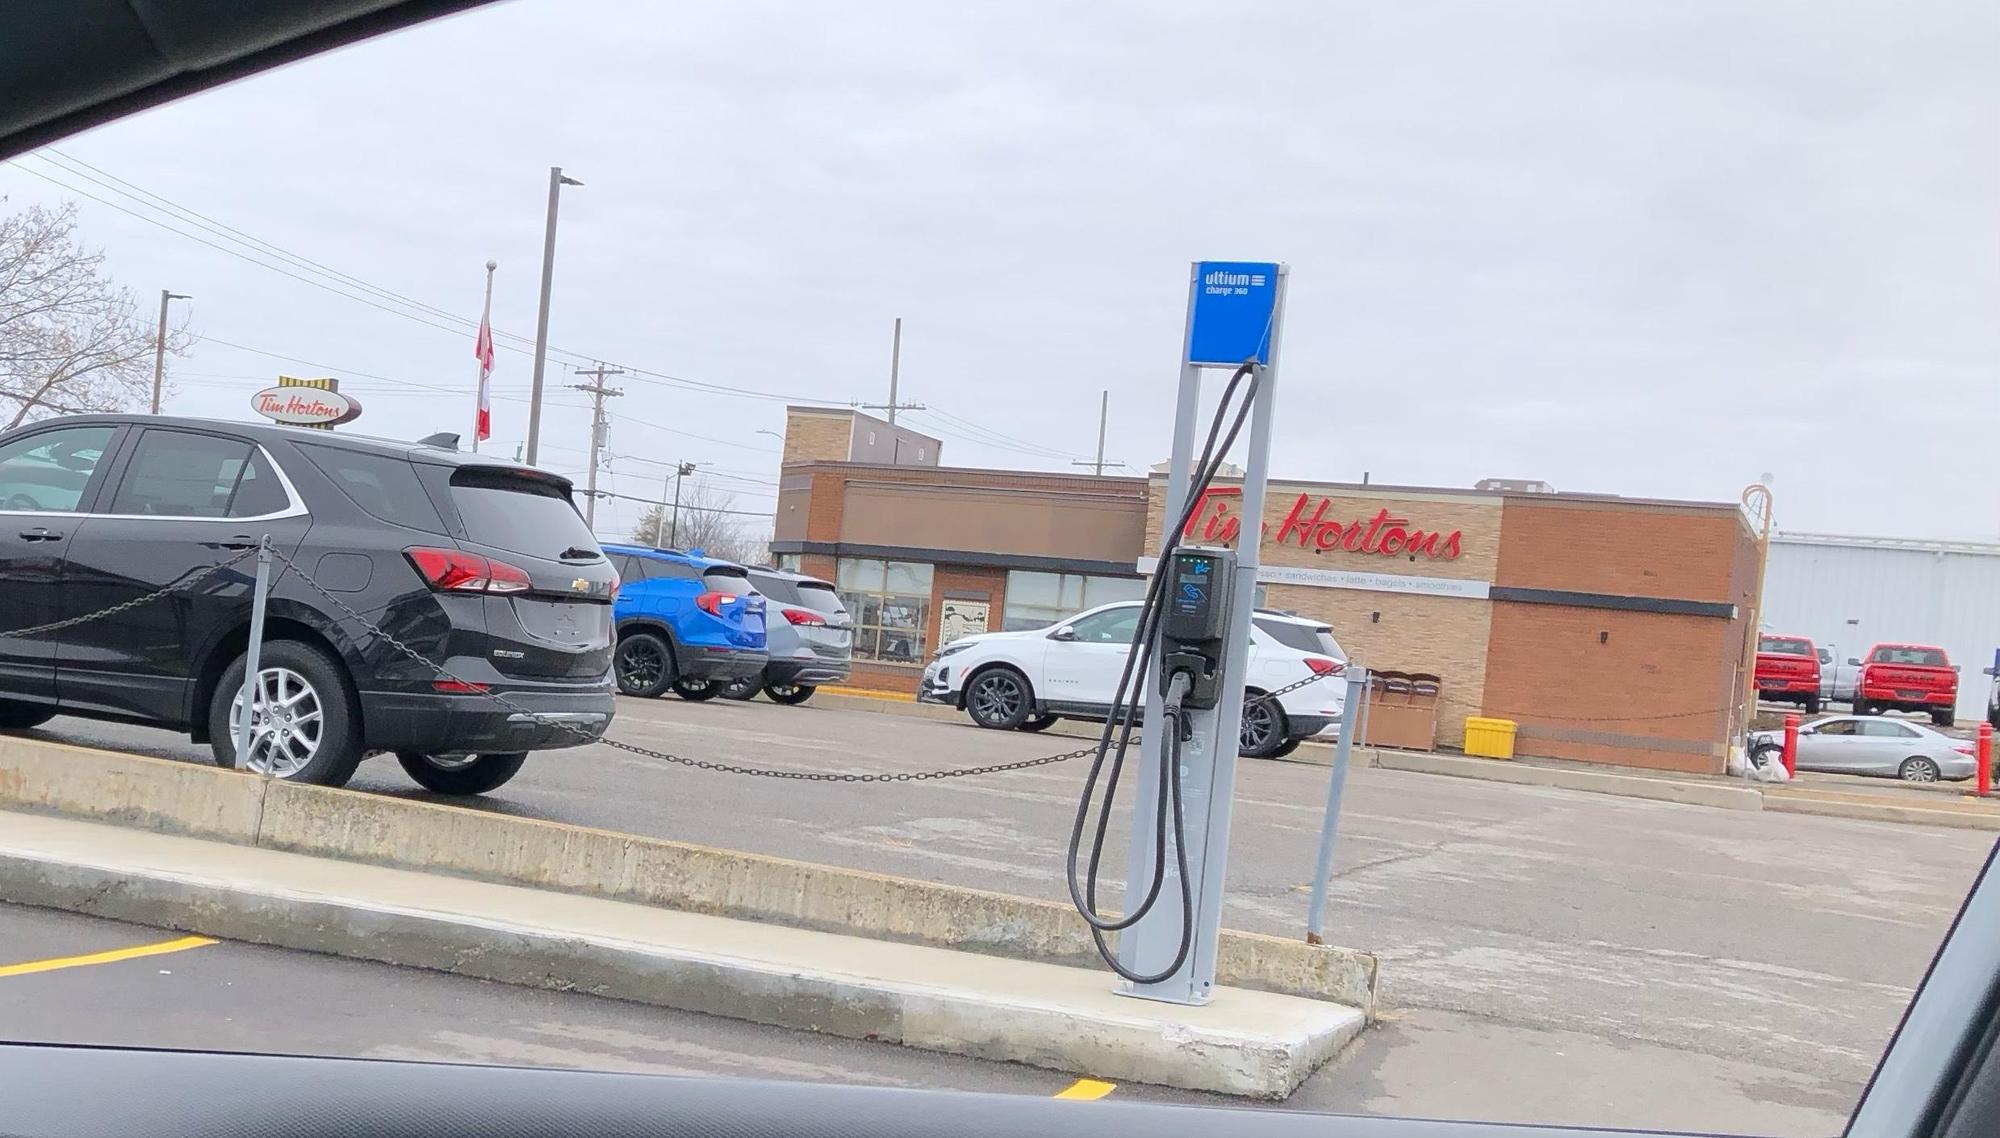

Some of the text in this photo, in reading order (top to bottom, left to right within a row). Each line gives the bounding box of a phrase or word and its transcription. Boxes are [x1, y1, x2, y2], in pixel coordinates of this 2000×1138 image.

[1205, 271, 1250, 286] ultium
[1205, 285, 1249, 296] charge 360
[259, 393, 341, 417] Tim Hortons
[1276, 492, 1462, 561] Hortons
[1284, 570, 1337, 582] sandwiches
[1345, 574, 1367, 584] latte
[1374, 577, 1407, 588] bagels
[1415, 580, 1463, 592] smoothies
